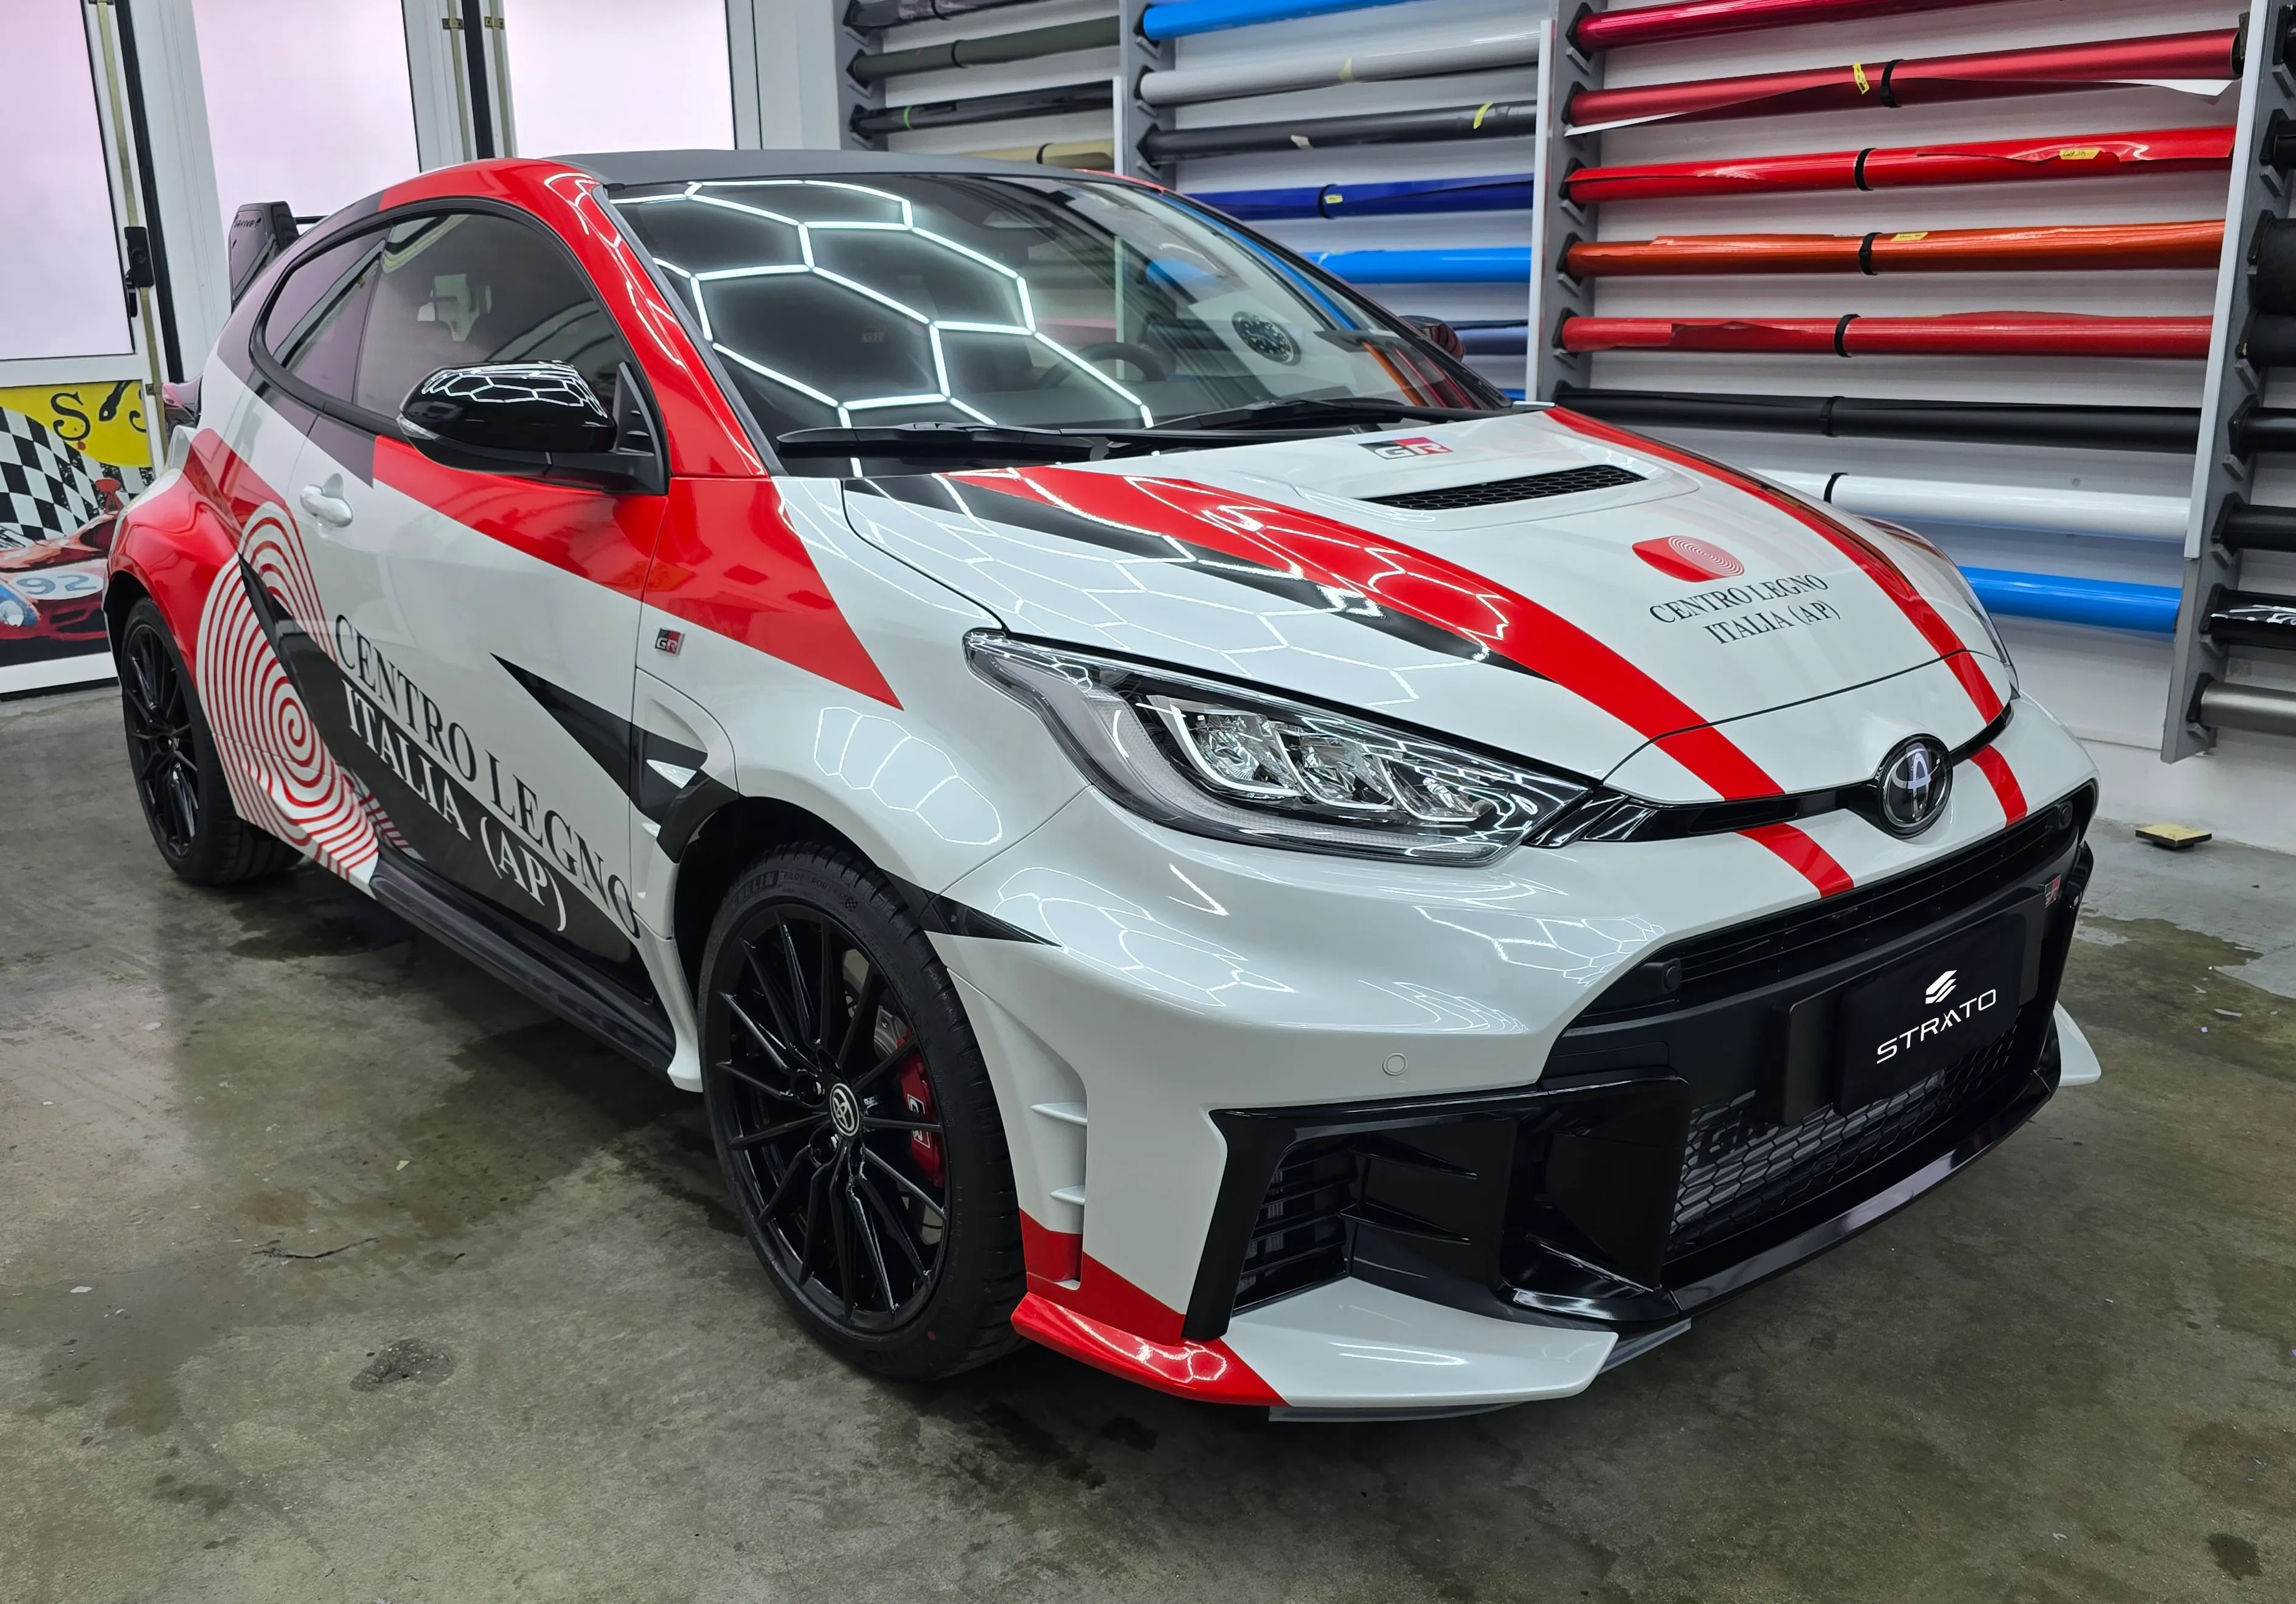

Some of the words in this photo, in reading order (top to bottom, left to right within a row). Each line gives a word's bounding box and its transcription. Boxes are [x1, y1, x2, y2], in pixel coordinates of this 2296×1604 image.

[862, 332, 884, 342] GR
[1375, 442, 1448, 458] GR
[16, 574, 97, 595] 92
[1649, 587, 1753, 623] CENTRO
[1746, 574, 1828, 601] LEGNO
[1703, 610, 1795, 645] ITALIA
[1788, 600, 1841, 626] (AP)
[335, 614, 477, 782] CENTRO
[485, 749, 640, 939] LEGNO
[341, 678, 471, 841] ITALIA
[480, 816, 567, 932] (AP)
[1876, 988, 1996, 1064] STRATO
